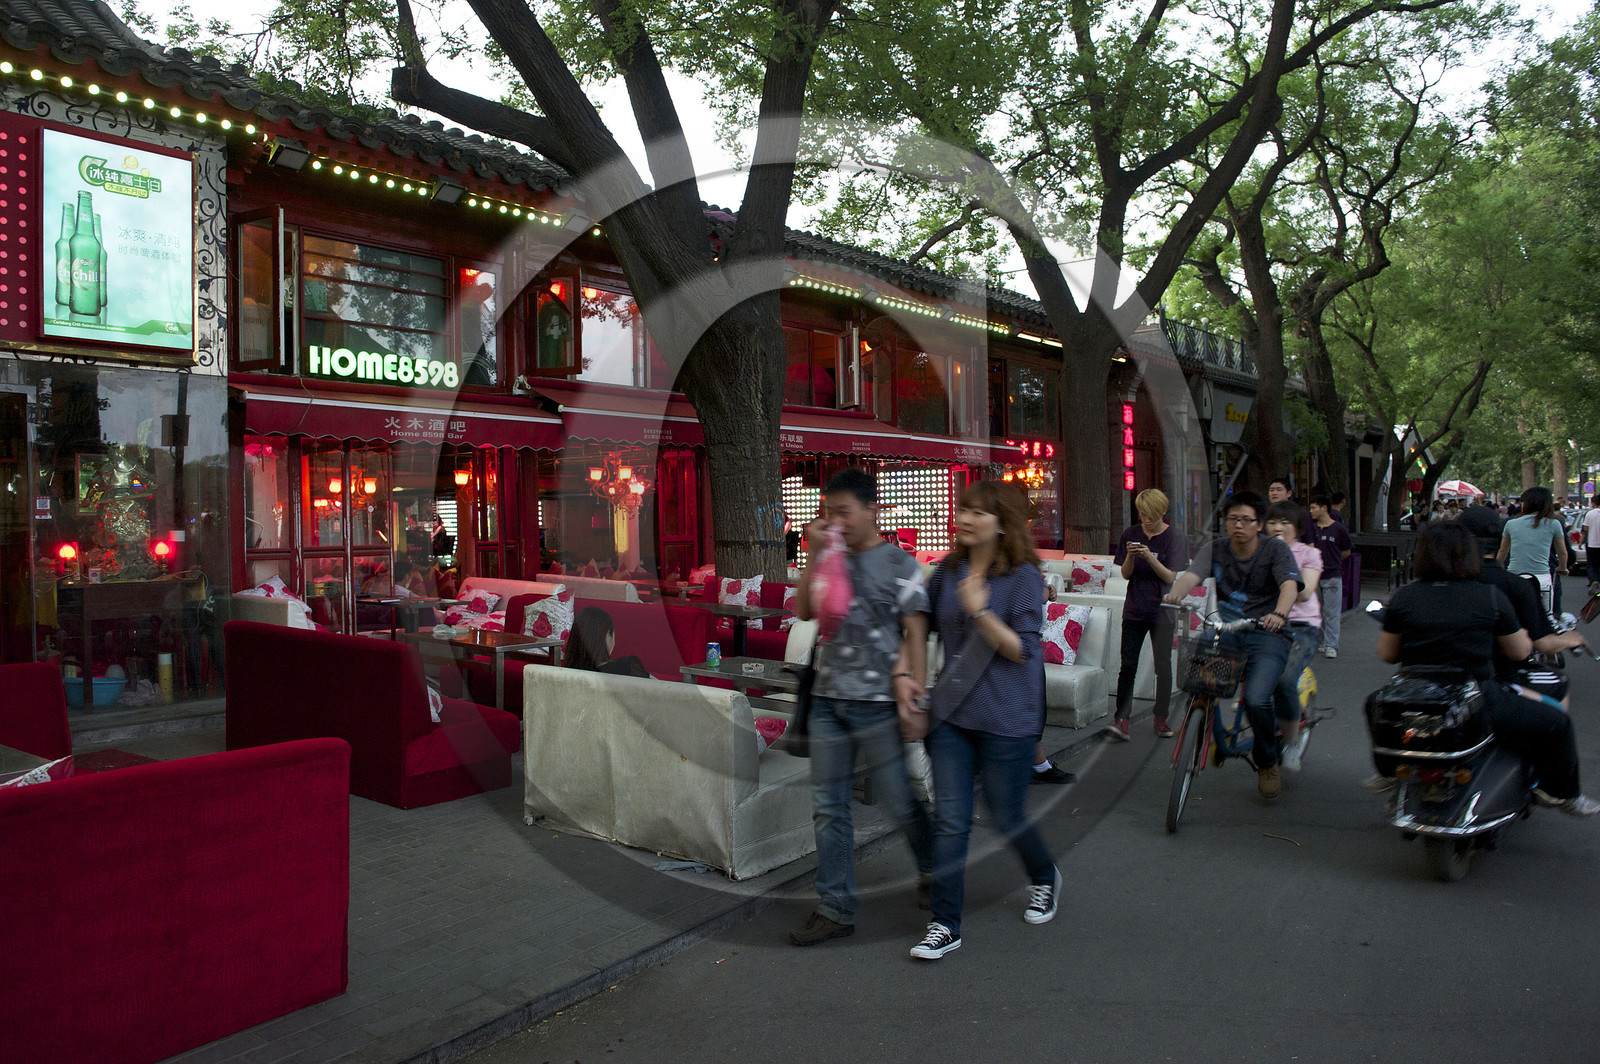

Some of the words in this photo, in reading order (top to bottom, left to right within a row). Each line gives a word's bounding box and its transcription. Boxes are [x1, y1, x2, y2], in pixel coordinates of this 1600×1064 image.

[89, 166, 161, 191] 冰纯嘉士伯
[73, 269, 98, 282] chill
[309, 345, 459, 388] HOME8598
[384, 416, 467, 433] 火木酒吧
[390, 429, 420, 438] Home
[422, 430, 445, 439] 8598
[448, 432, 464, 440] Bar
